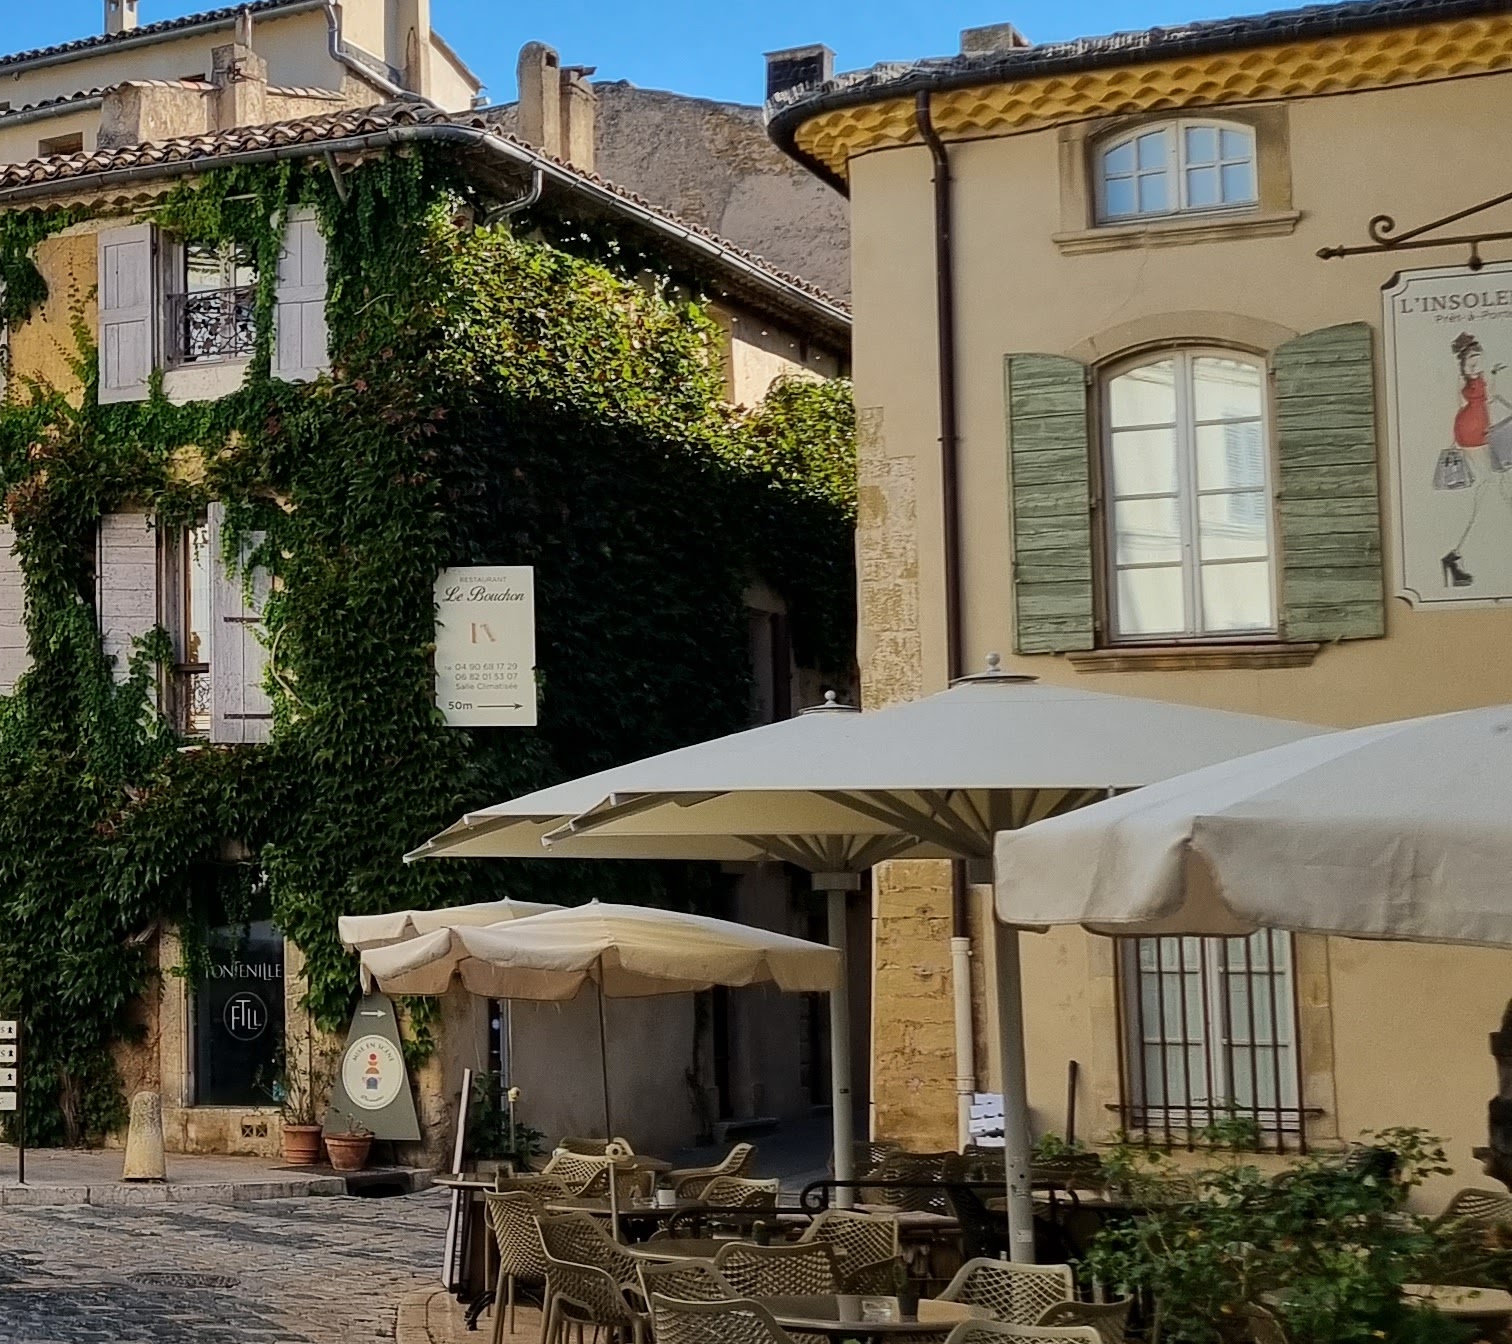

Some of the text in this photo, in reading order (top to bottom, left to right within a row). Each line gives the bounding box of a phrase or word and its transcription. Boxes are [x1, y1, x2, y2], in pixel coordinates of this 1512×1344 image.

[1400, 290, 1512, 314] L'INSOLE
[442, 585, 525, 602] Le Bouchon
[455, 663, 467, 671] 04
[448, 701, 473, 710] 50m
